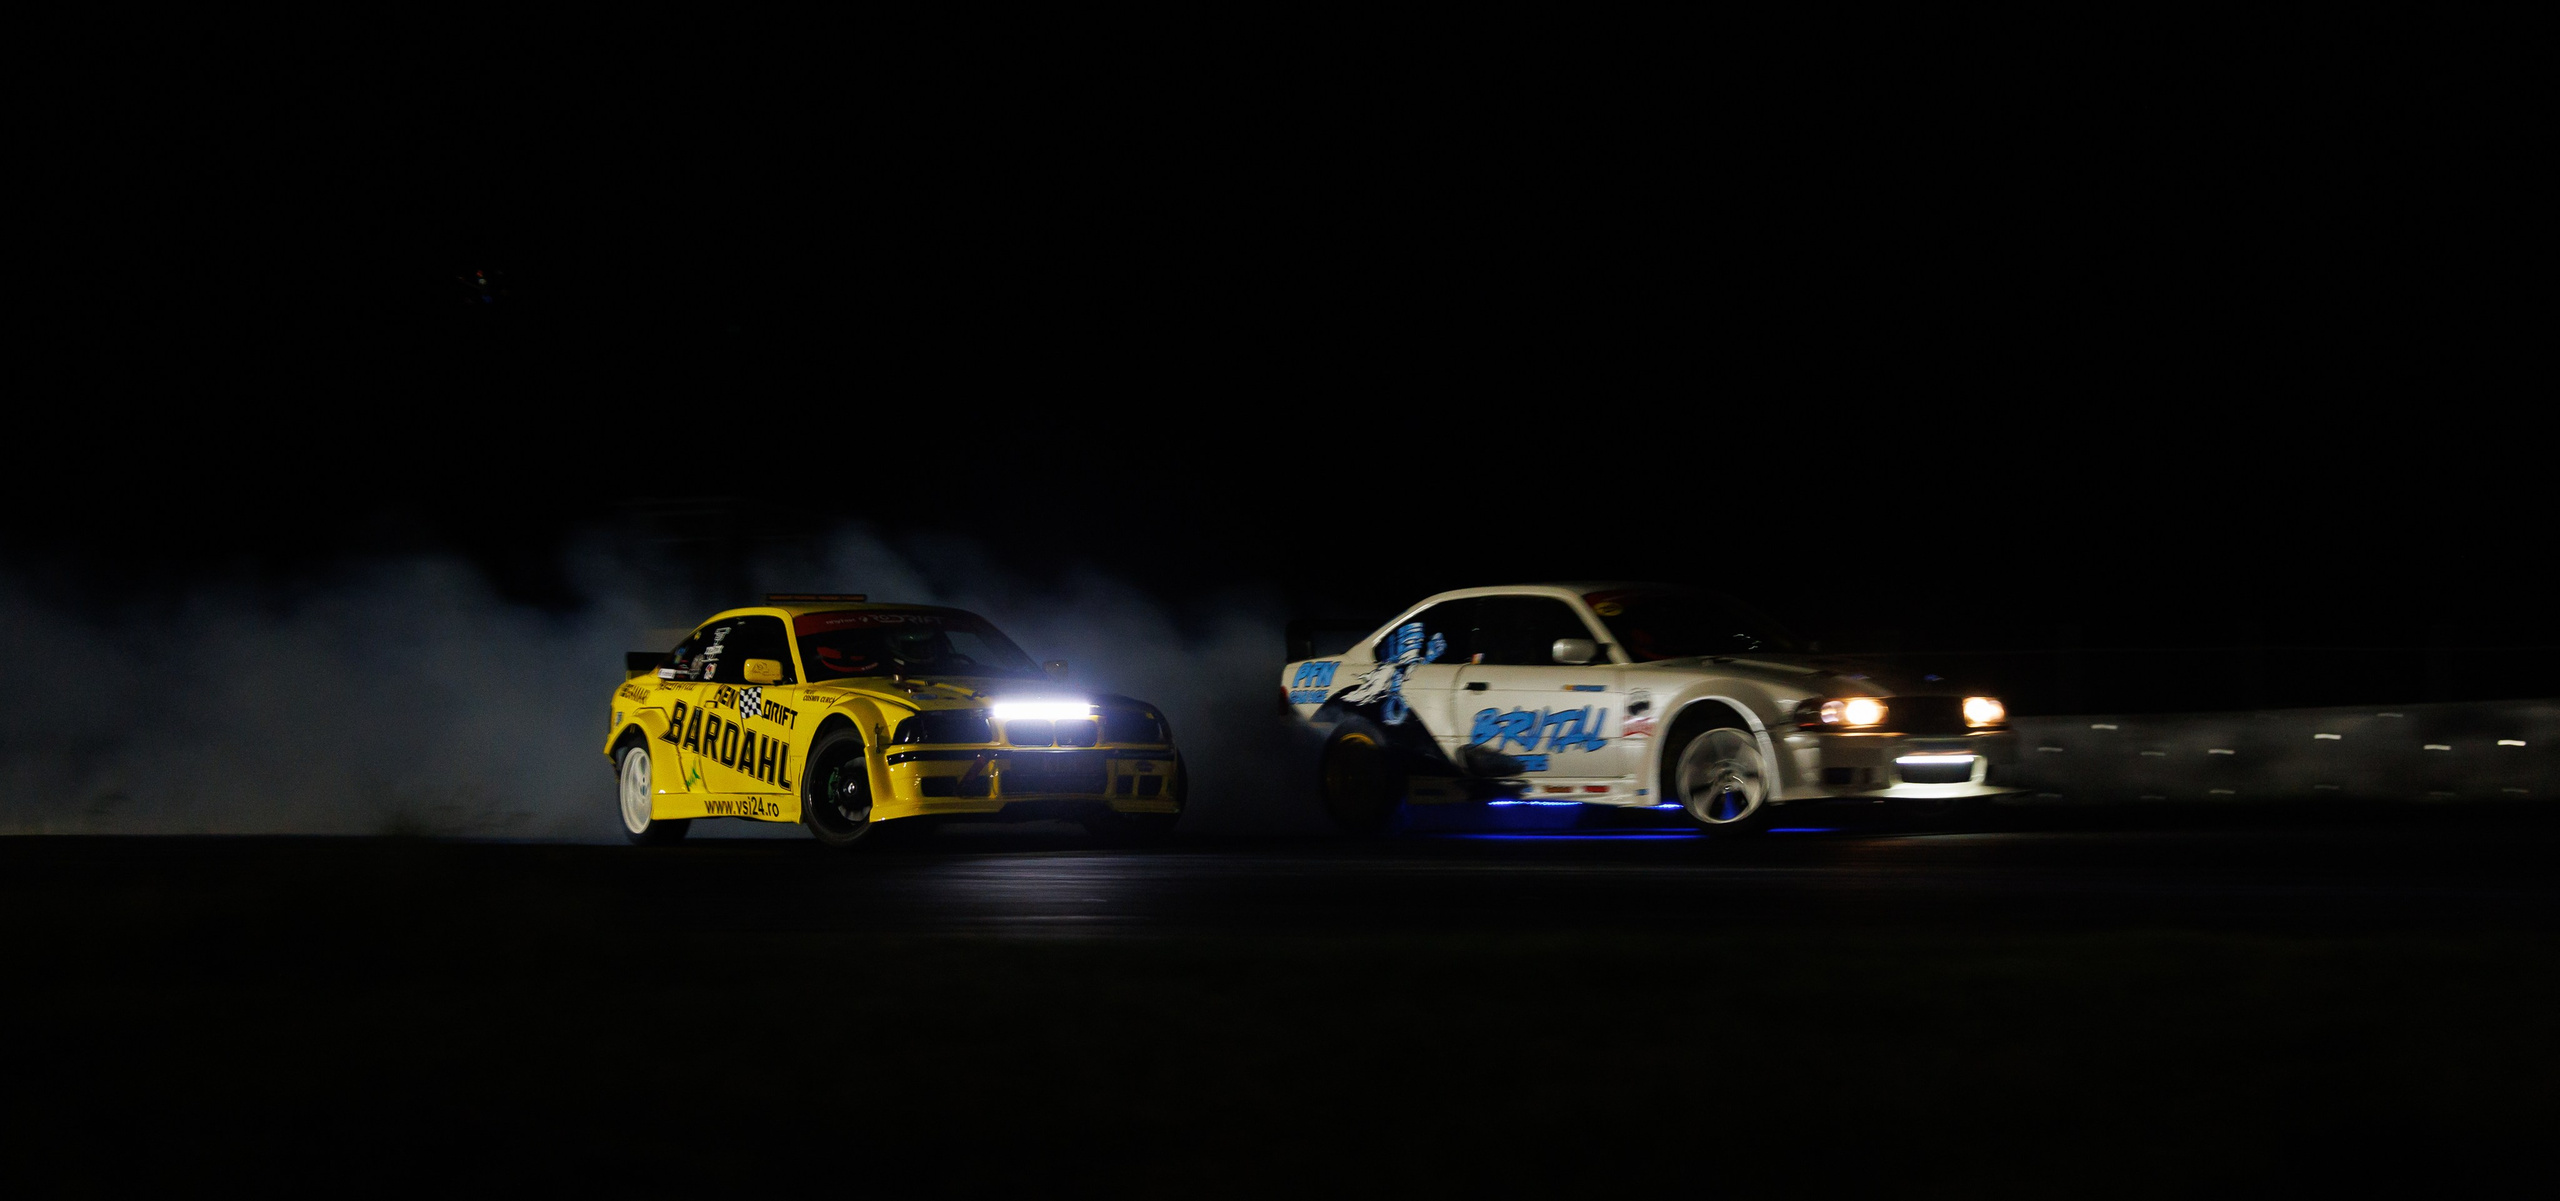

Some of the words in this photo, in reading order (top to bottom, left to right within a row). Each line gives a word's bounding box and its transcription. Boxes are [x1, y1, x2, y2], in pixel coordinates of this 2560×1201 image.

[1292, 661, 1341, 688] PFN
[763, 699, 798, 730] DRIFT
[1470, 705, 1608, 753] BRUTAL
[659, 699, 792, 791] BARDAHL
[704, 796, 780, 817] www.vsi24.ro
